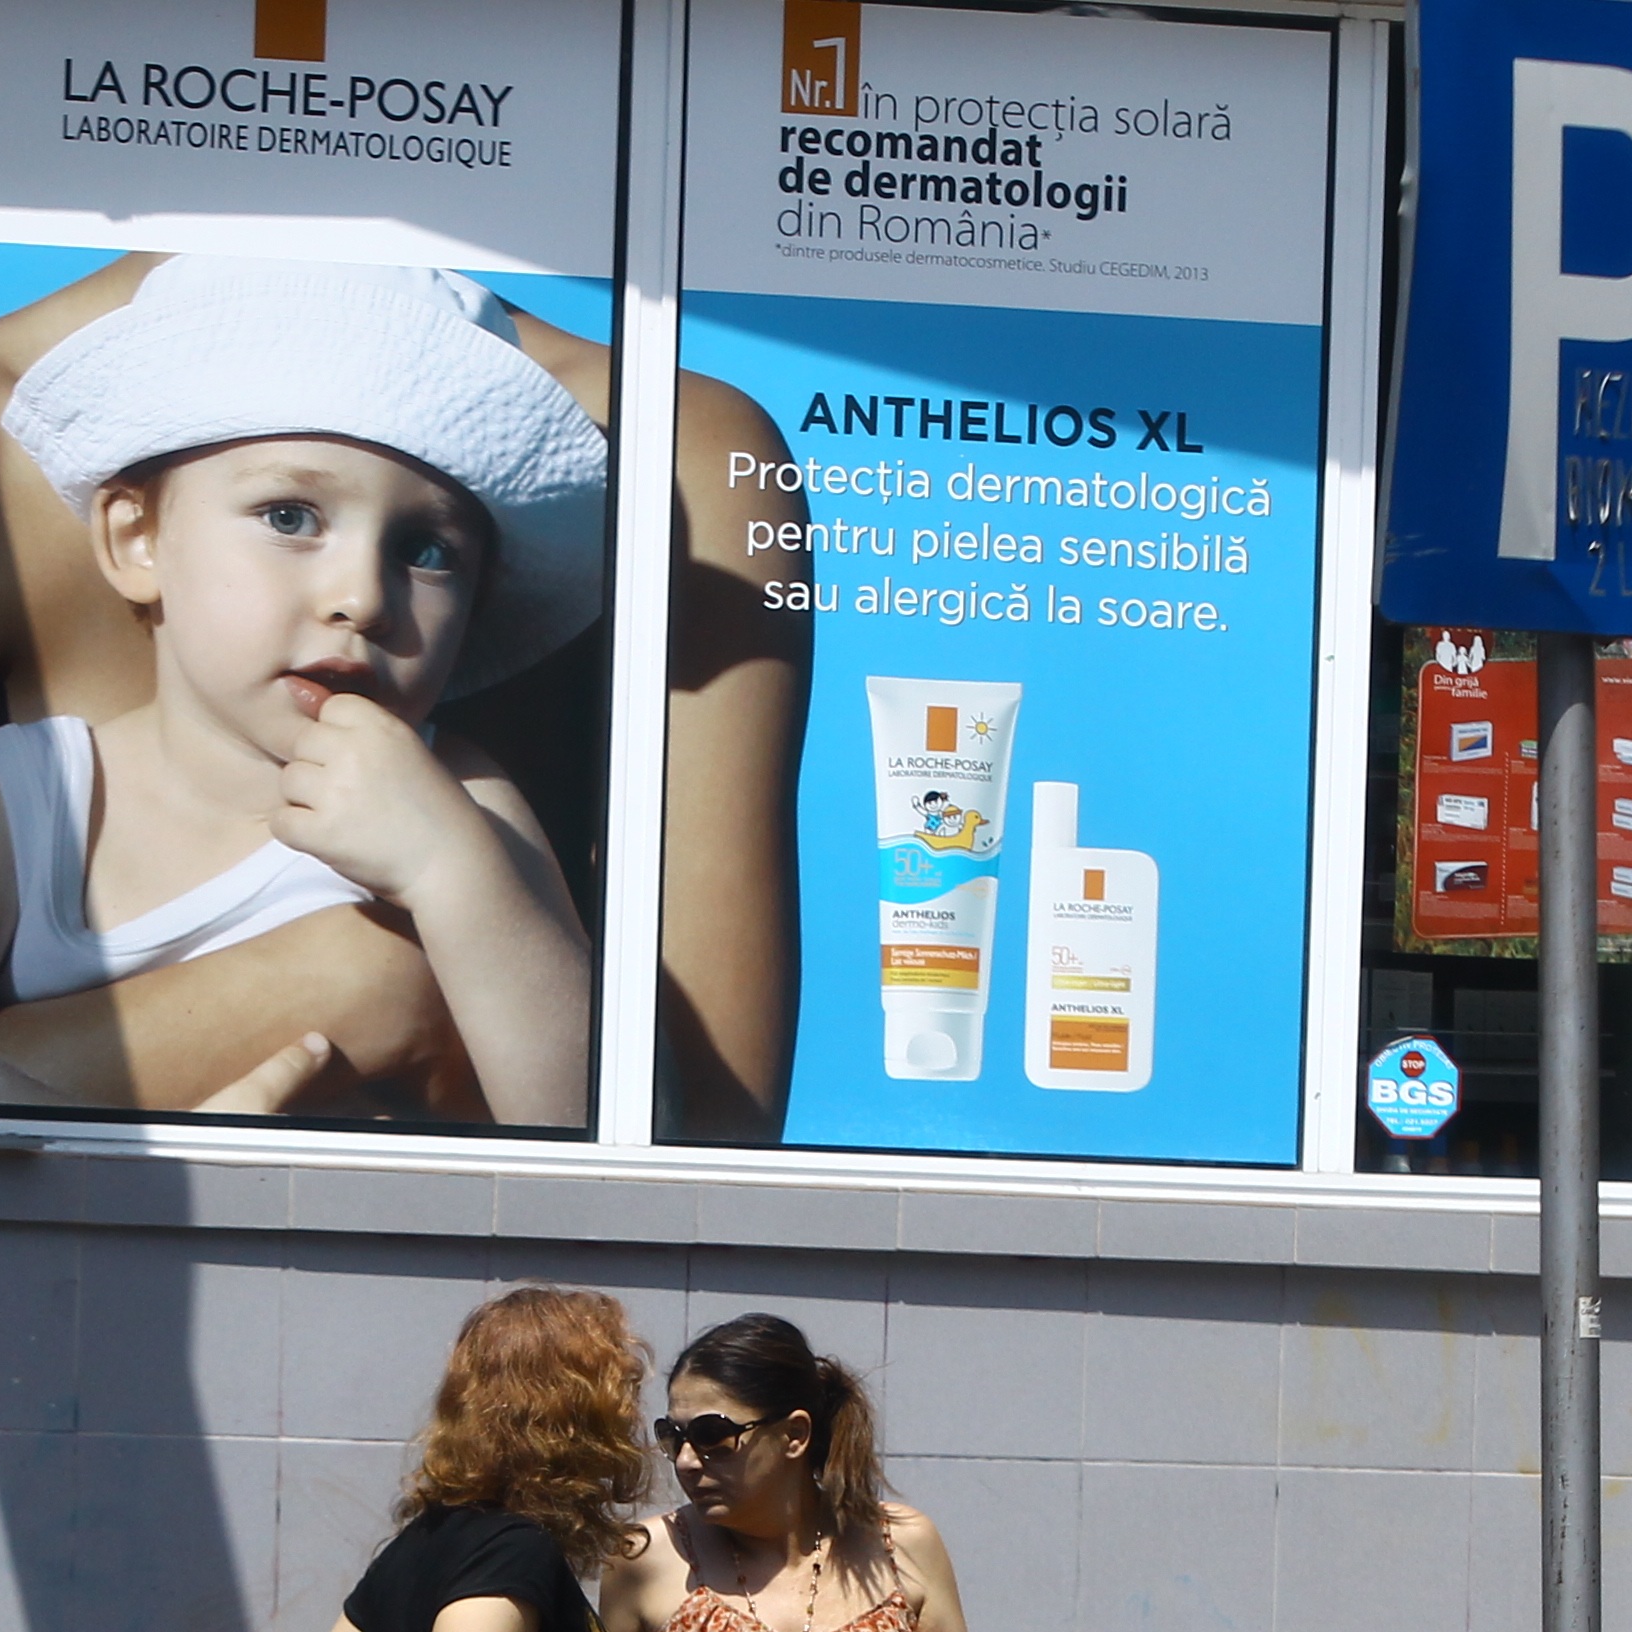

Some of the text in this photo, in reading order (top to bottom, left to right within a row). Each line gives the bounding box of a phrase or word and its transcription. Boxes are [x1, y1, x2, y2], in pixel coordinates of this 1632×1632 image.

[63, 57, 514, 128] LA ROCHE-POSAY
[861, 82, 898, 121] în
[914, 94, 1099, 141] protecția
[1113, 98, 1232, 141] solară
[62, 114, 512, 168] LABORATOIRE DERMATOLOGIQUE
[780, 125, 1043, 168] recomandat
[778, 156, 1128, 220] de dermatologii
[776, 198, 842, 239] din
[829, 247, 902, 266] produsele
[906, 251, 1047, 273] dermatocosmetice.
[1049, 258, 1096, 275] Studiu
[1099, 261, 1170, 281] CEGEDIM,
[1174, 266, 1209, 281] 2013
[799, 392, 1204, 455] ANTHELIOS XL
[728, 450, 1273, 521] Protecția dermatologică
[746, 517, 1249, 575] pentru pielea sensibilă
[1588, 540, 1606, 597] 2
[762, 577, 1229, 633] sau alergică la soare.
[888, 757, 993, 772] LA ROCHE-POSAY
[892, 910, 956, 920] ANTHELIOS
[1051, 1003, 1125, 1015] ANTHELIOS XL
[1402, 1059, 1425, 1069] STOP
[1371, 1079, 1455, 1106] BGS
